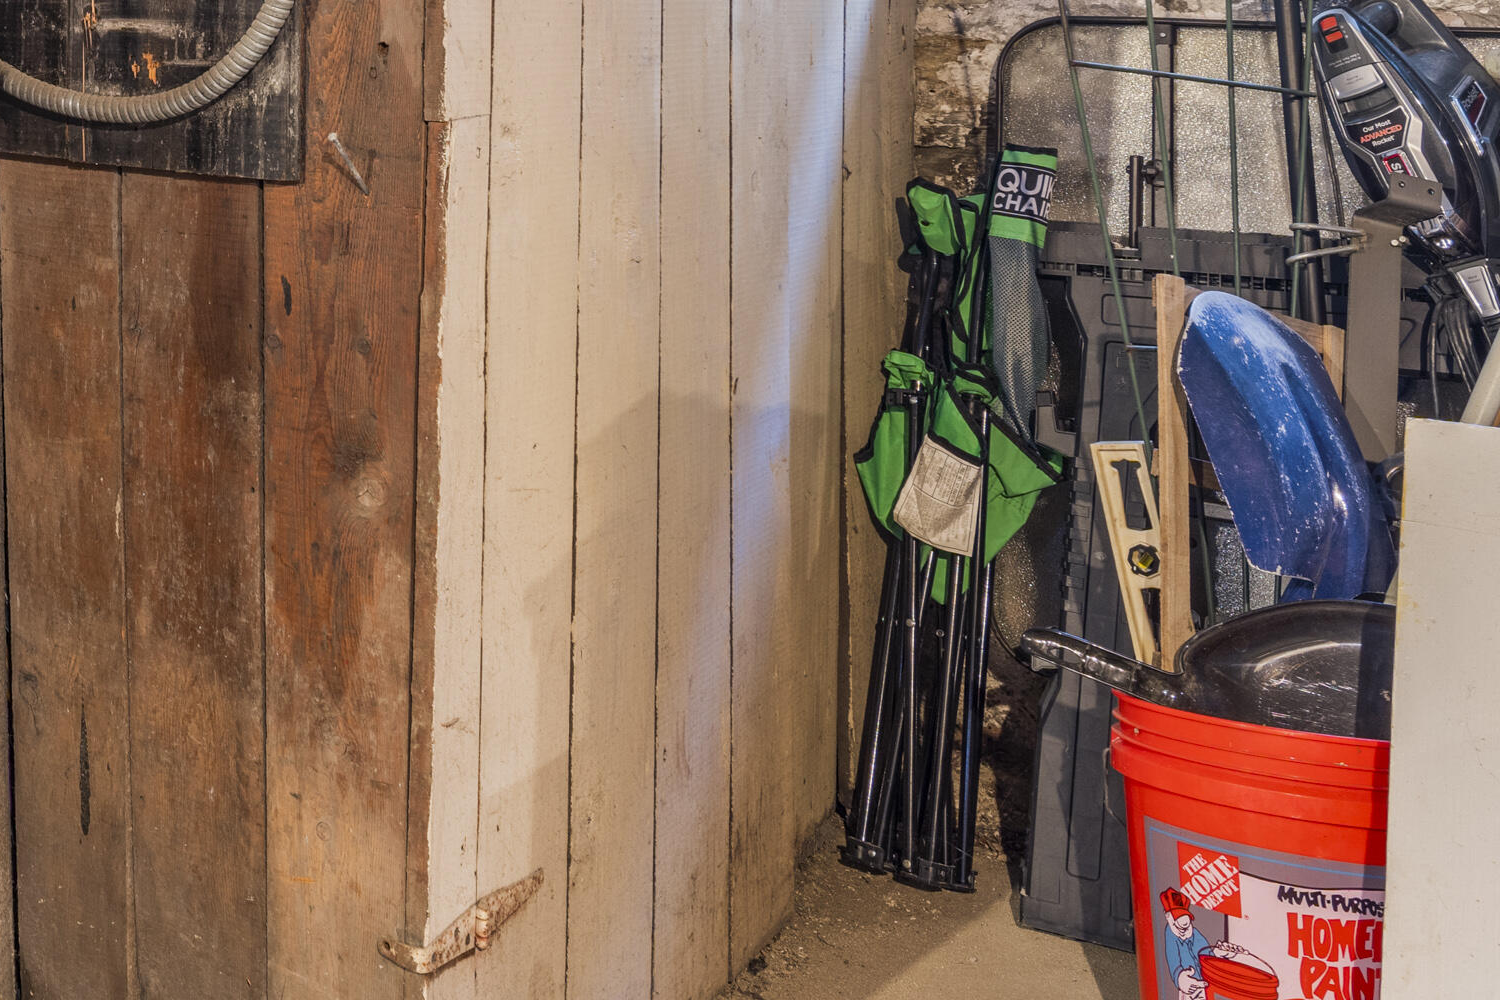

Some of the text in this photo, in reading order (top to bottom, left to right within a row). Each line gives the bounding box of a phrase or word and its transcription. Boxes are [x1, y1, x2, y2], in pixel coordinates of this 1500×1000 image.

[1360, 124, 1403, 144] ADVANCED
[1362, 119, 1392, 133] Our Most
[1180, 855, 1239, 905] HOME
[1182, 853, 1208, 876] THE
[1200, 879, 1240, 911] DEPOT
[1277, 885, 1385, 918] MULTI-PURPOS
[1299, 956, 1382, 1000] PAIN
